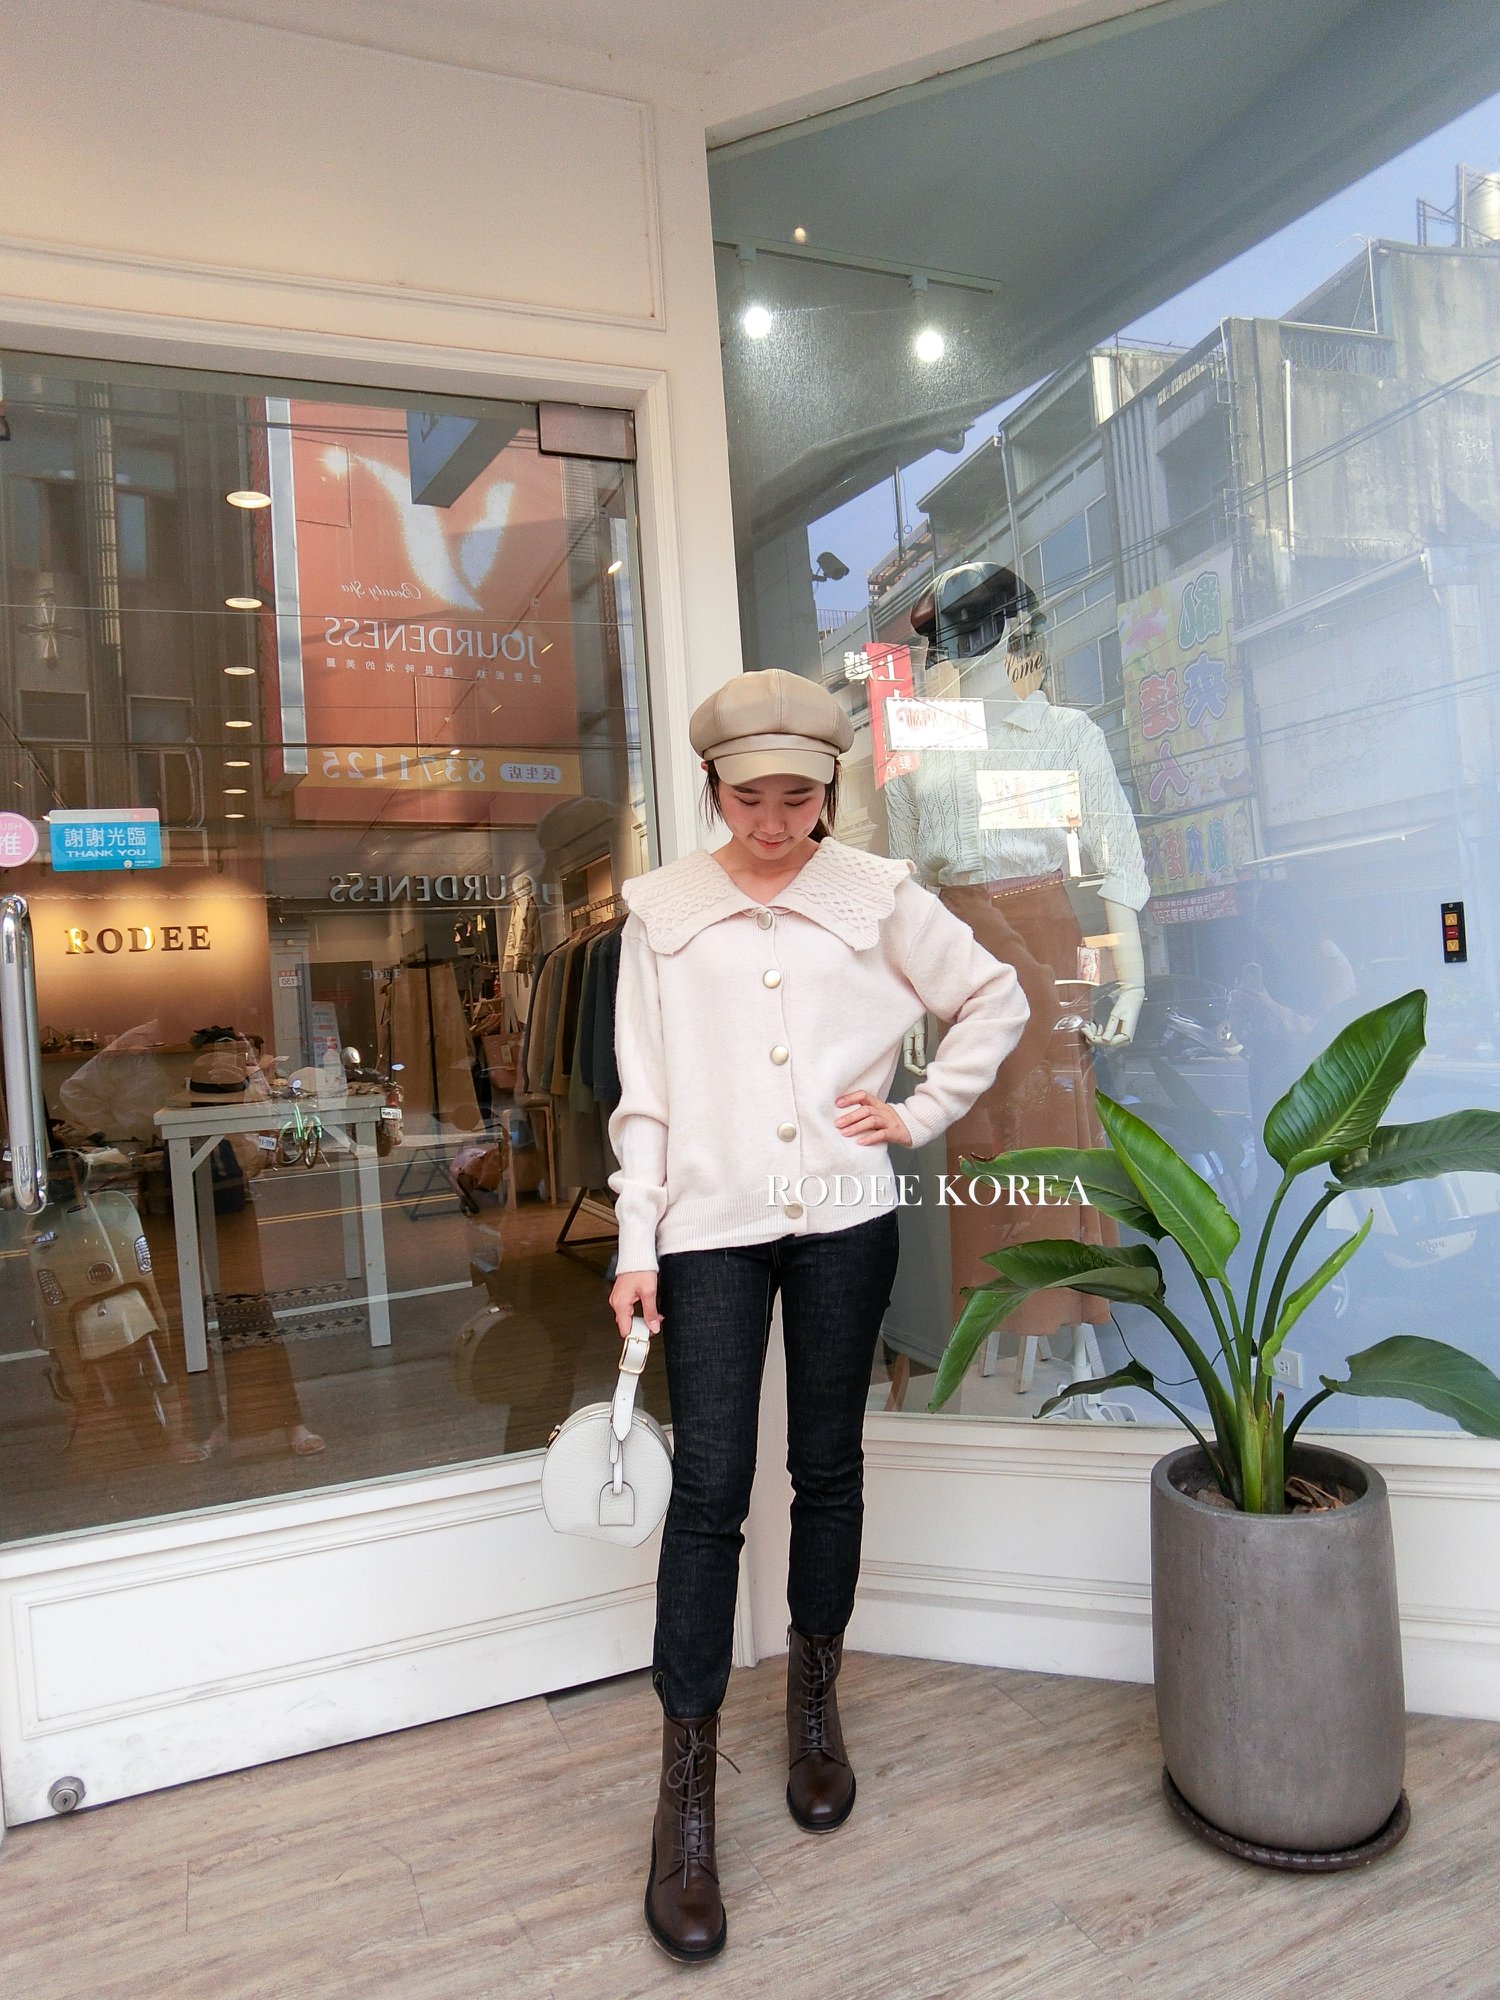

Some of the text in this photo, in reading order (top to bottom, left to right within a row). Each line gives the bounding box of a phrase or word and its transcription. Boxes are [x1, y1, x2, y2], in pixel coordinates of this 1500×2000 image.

[0, 822, 22, 831] USH
[63, 826, 147, 849] 謝謝光臨
[65, 849, 147, 858] THANK YOU
[64, 925, 211, 955] RODEE
